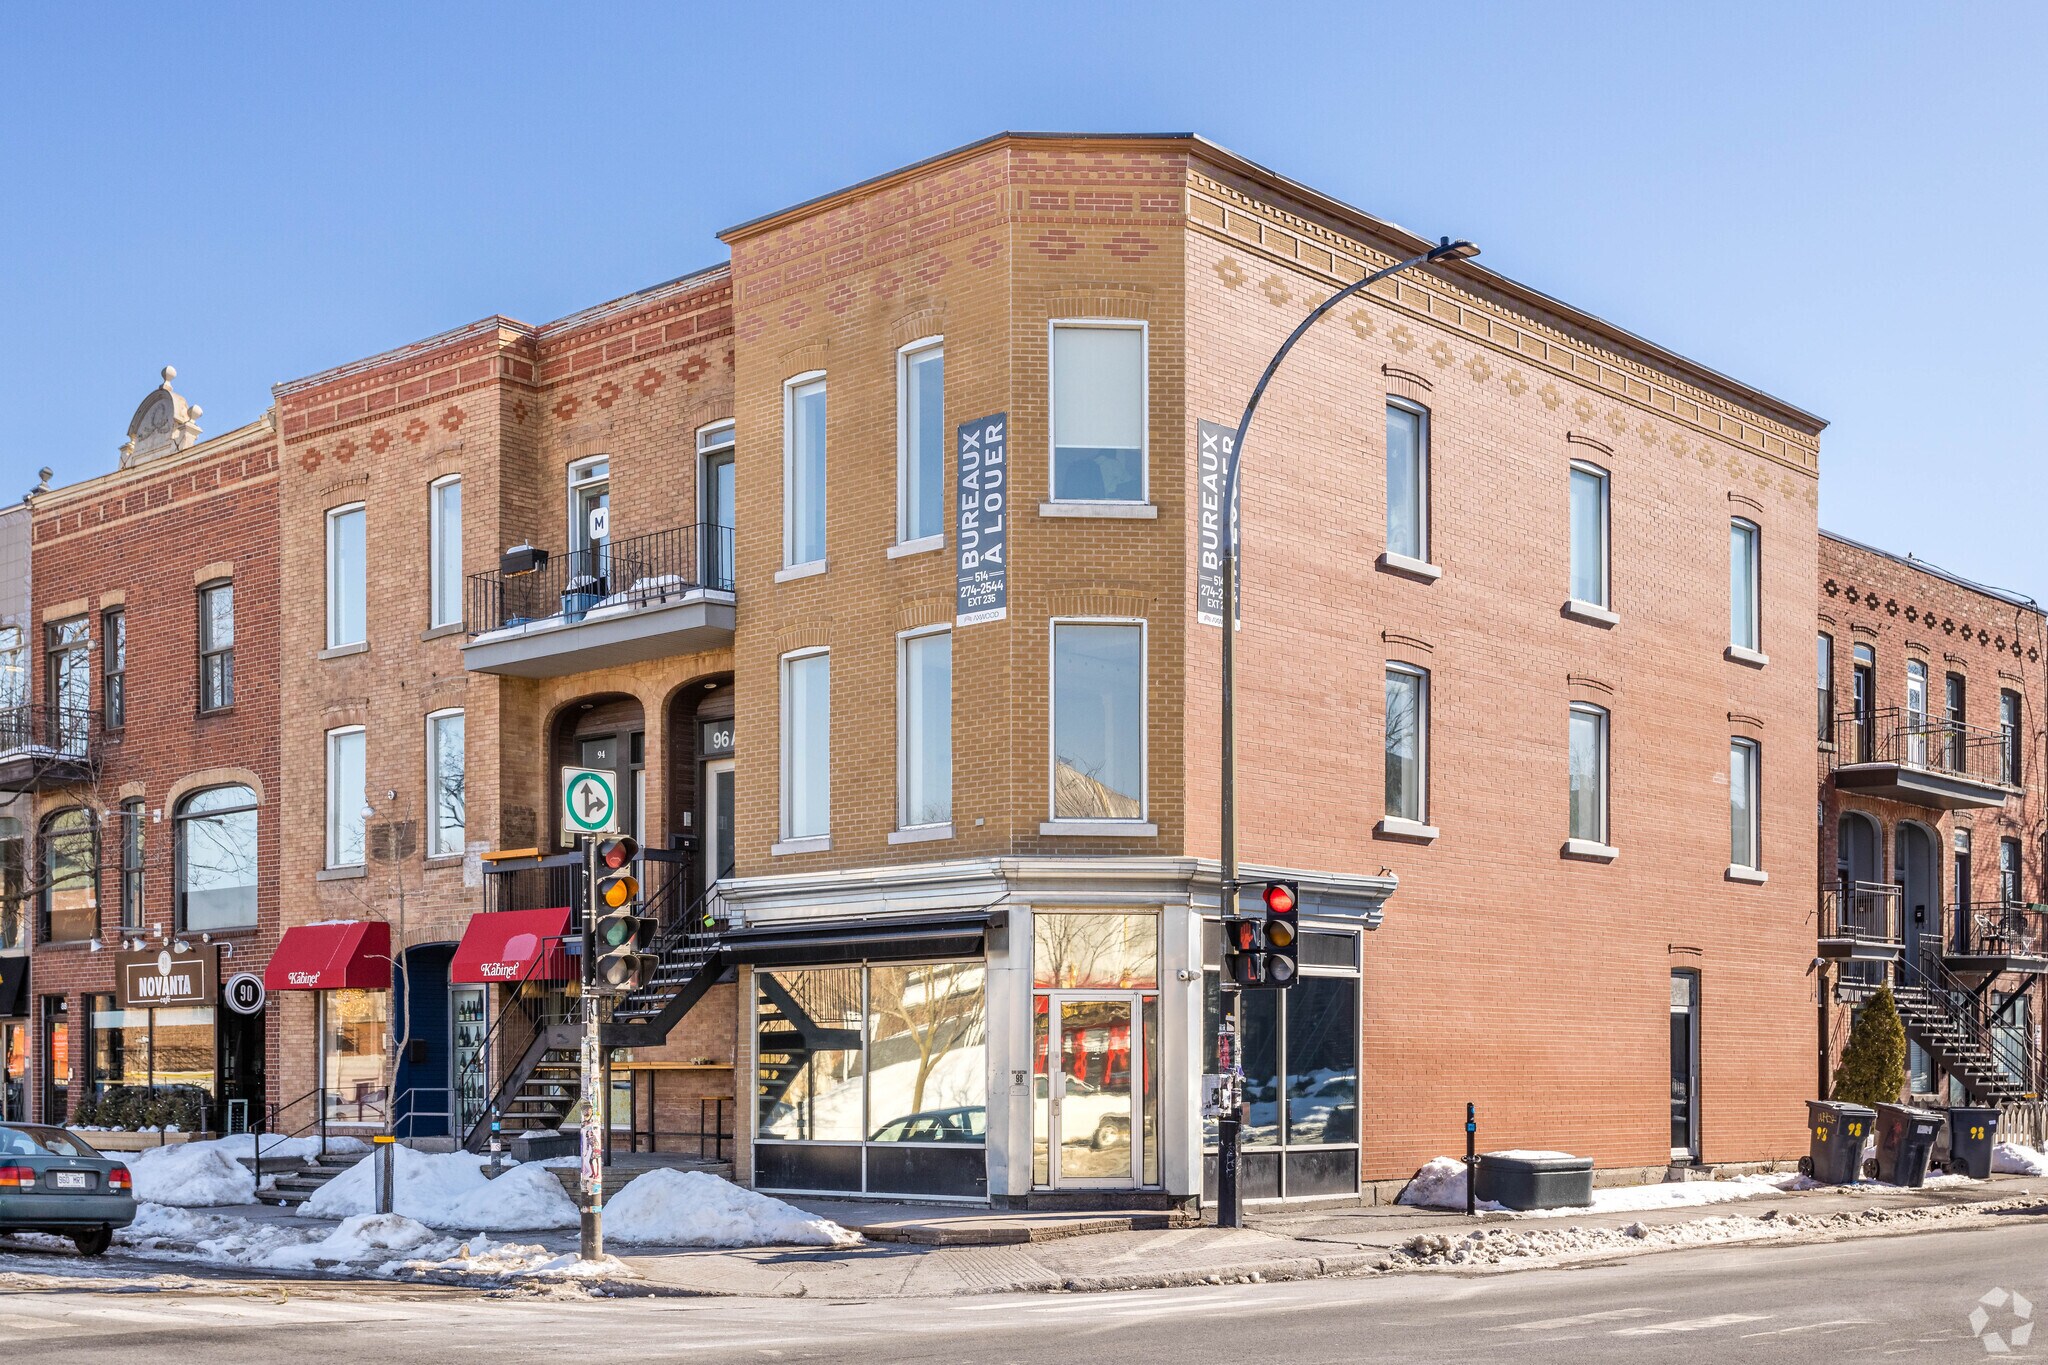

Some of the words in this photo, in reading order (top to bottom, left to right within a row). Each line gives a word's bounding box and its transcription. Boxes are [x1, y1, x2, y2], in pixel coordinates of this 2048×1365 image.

[984, 422, 1003, 534] LOUER
[962, 429, 980, 570] BUREAUX
[1202, 430, 1219, 571] BUREAUX
[980, 542, 1003, 564] À
[974, 570, 989, 583] 514
[960, 579, 1004, 598] 274-2544
[967, 596, 982, 607] EXT
[983, 593, 996, 605] 235
[1207, 597, 1220, 609] EXT
[597, 750, 606, 759] 94
[480, 962, 520, 979] Kabinet
[138, 975, 192, 997] NOVANTA
[288, 971, 321, 986] Kabinet
[240, 985, 253, 1001] 90
[1015, 1074, 1024, 1083] 98
[1848, 1122, 1862, 1137] 98
[1970, 1126, 1985, 1140] 98
